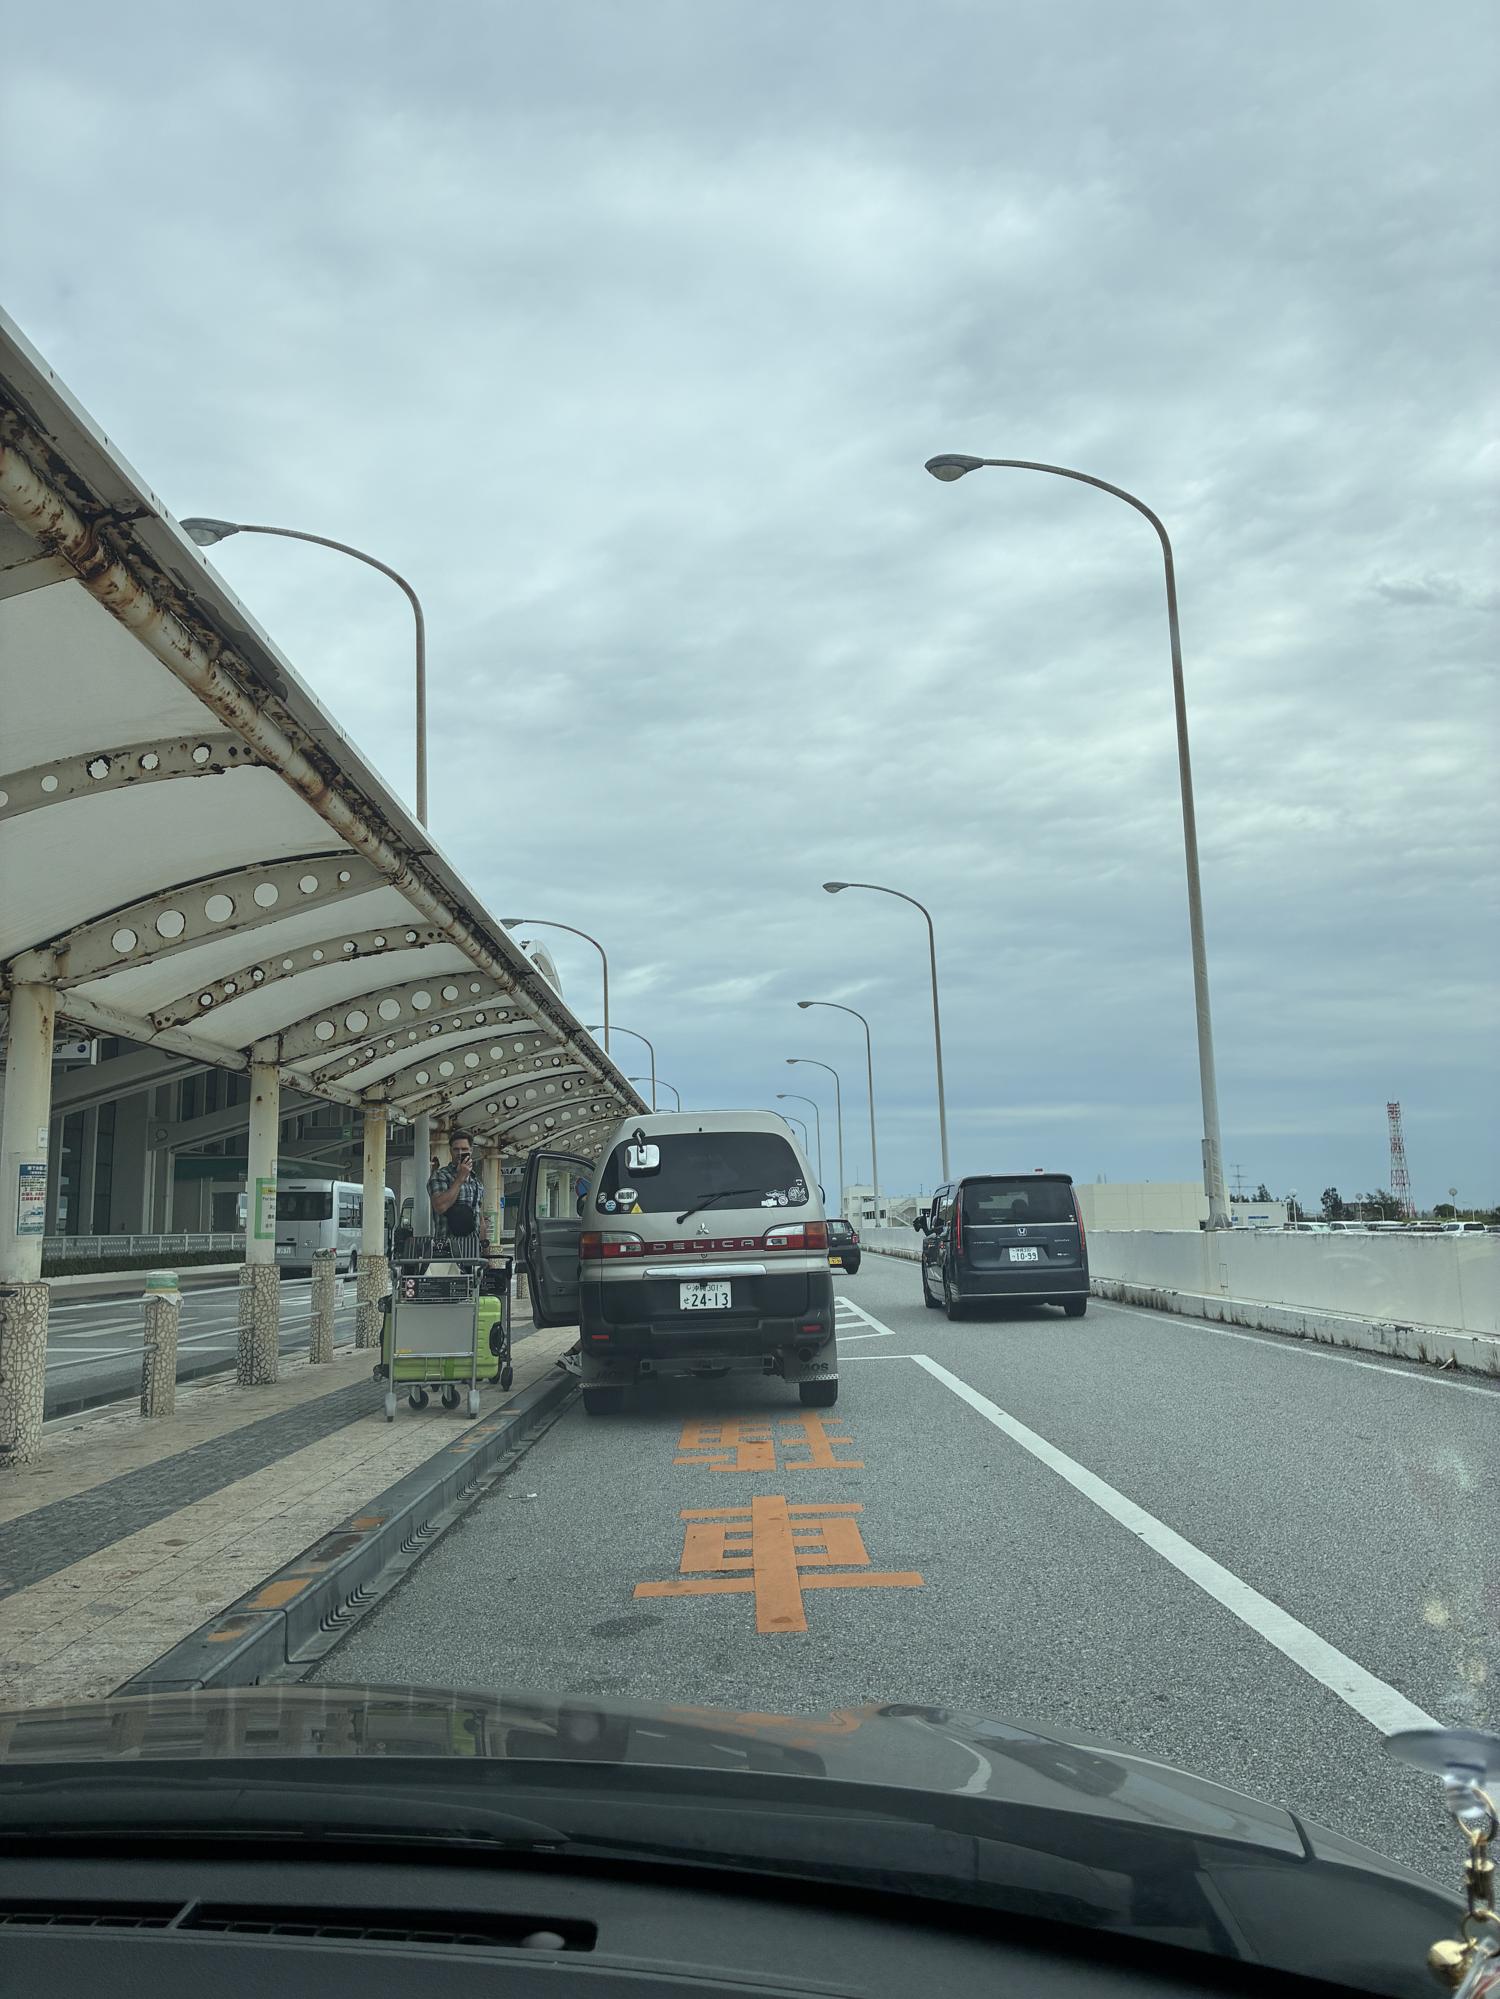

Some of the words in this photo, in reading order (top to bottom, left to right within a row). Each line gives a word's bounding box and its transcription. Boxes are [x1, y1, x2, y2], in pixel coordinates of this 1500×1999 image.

[653, 1239, 755, 1251] DELICA
[1016, 1252, 1037, 1260] 10-99
[707, 1284, 719, 1292] 301
[691, 1292, 729, 1307] 24-13
